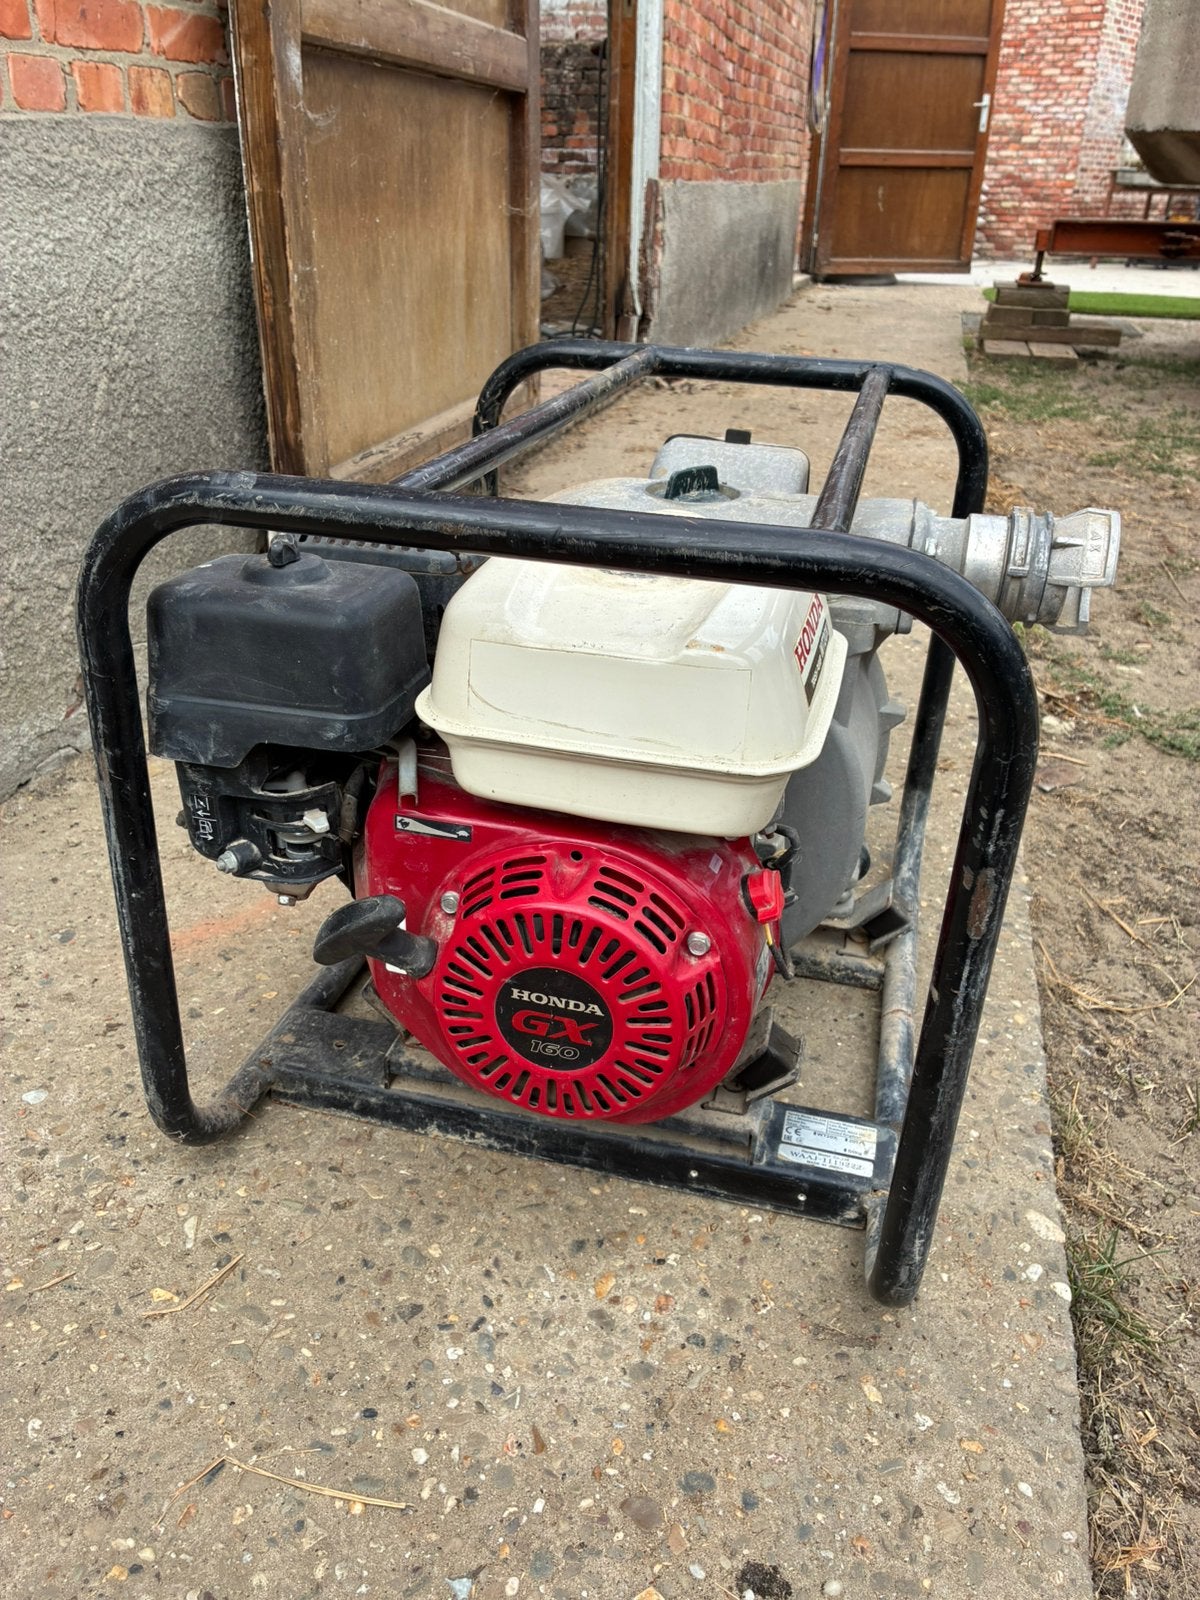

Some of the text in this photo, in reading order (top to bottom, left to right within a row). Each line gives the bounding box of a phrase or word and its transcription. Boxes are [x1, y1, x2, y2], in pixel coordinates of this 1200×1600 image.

[794, 593, 823, 673] HONDA
[511, 988, 604, 1016] HONDA
[512, 1010, 600, 1046] GX
[531, 1040, 580, 1060] 160
